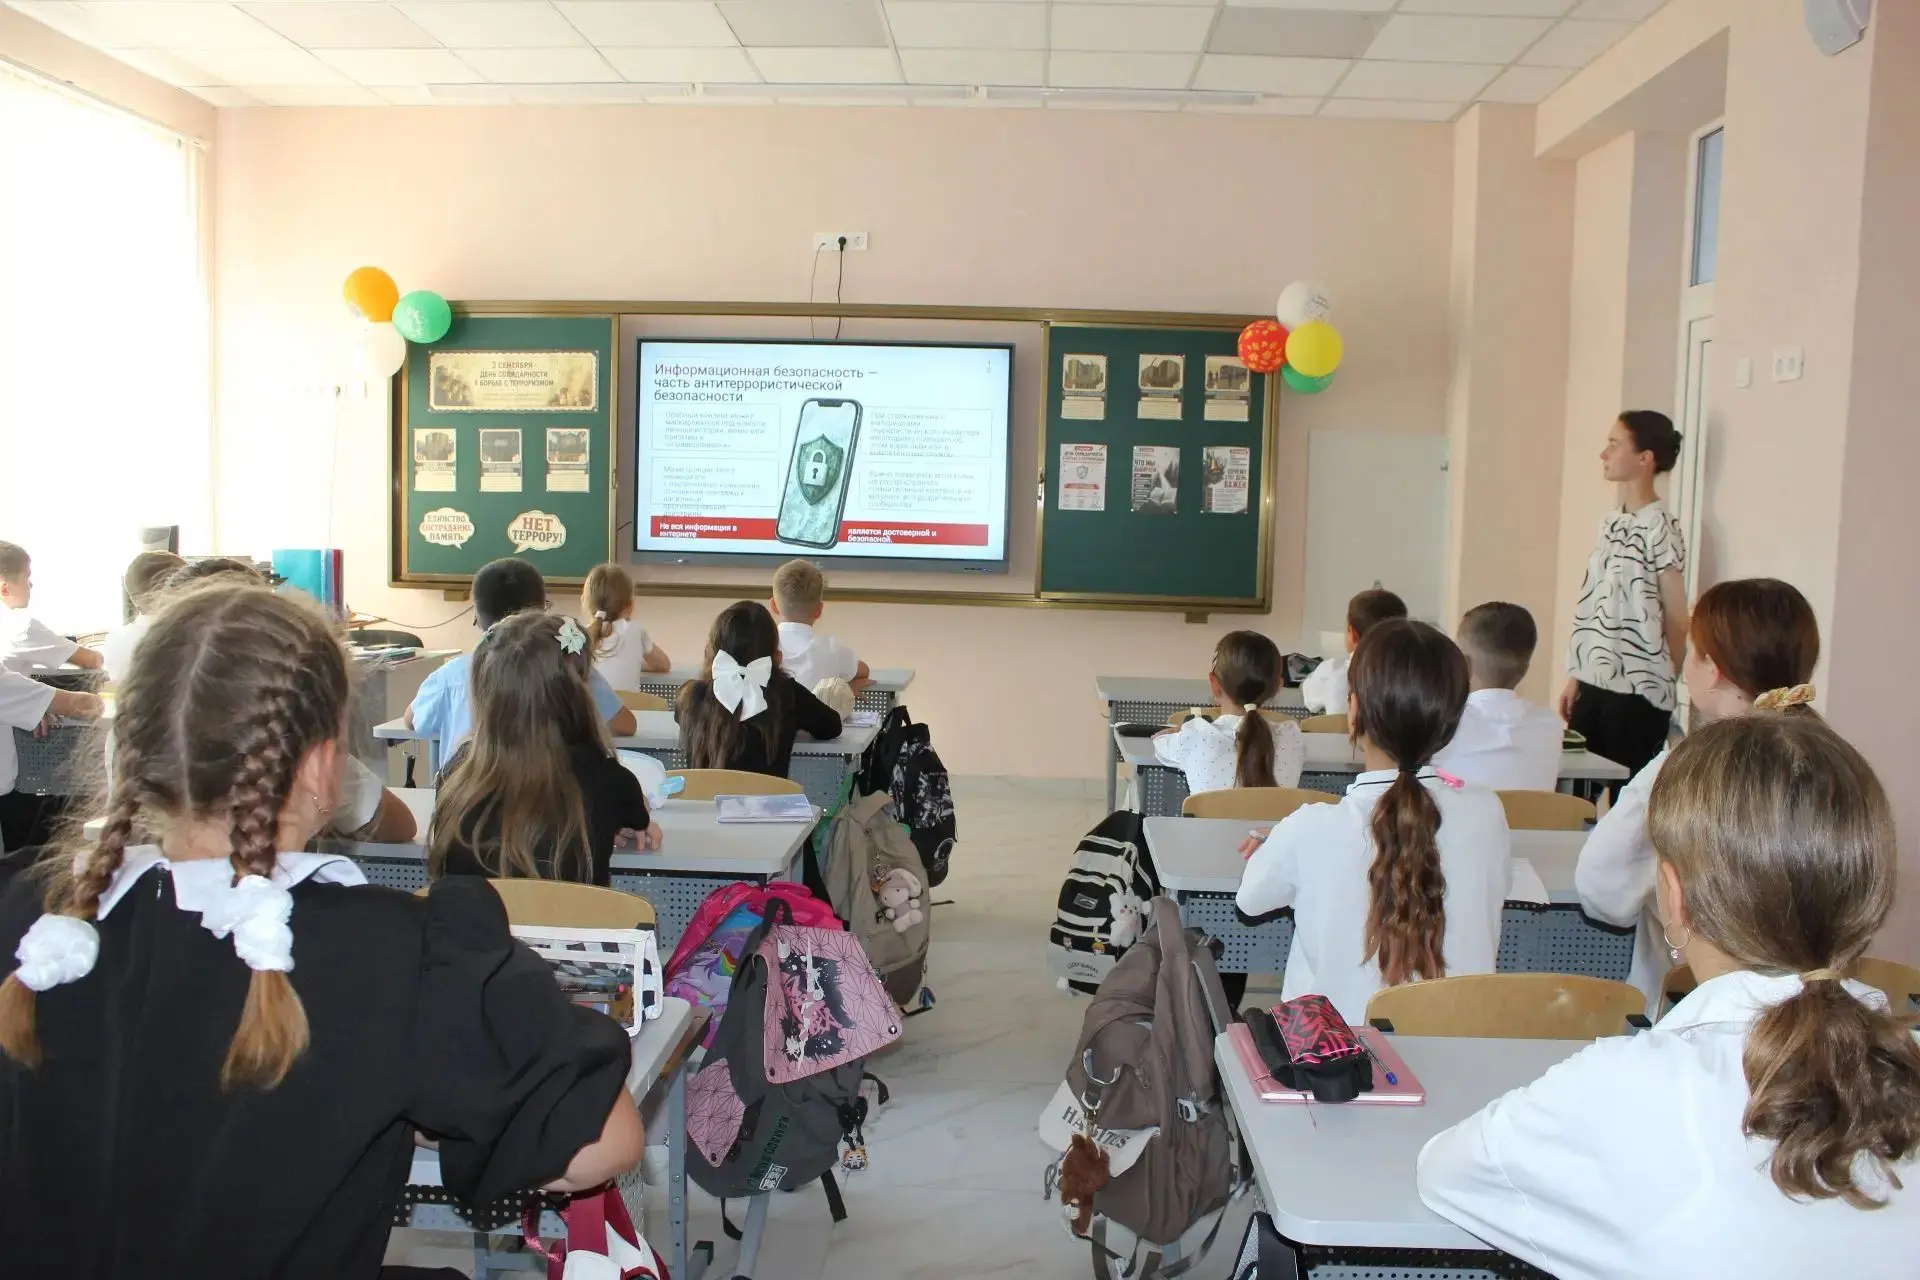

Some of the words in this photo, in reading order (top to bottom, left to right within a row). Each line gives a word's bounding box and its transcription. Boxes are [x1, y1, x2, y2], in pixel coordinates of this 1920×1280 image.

[498, 361, 533, 369] СЕНТЯБРЯ
[654, 363, 770, 378] Информационная
[773, 365, 864, 379] безопасность
[480, 370, 497, 378] ДЕНЬ
[498, 370, 548, 378] СОЛИДАРНОСТИ
[654, 379, 690, 389] часть
[693, 379, 843, 392] антитеррористической
[654, 389, 743, 402] безопасности
[522, 516, 553, 531] НЕТ
[659, 522, 670, 531] Не
[671, 523, 683, 531] вся
[684, 523, 732, 533] информация
[512, 530, 562, 543] ТЕРРОРУ!
[660, 531, 697, 539] интернете
[883, 529, 930, 538] достоверной
